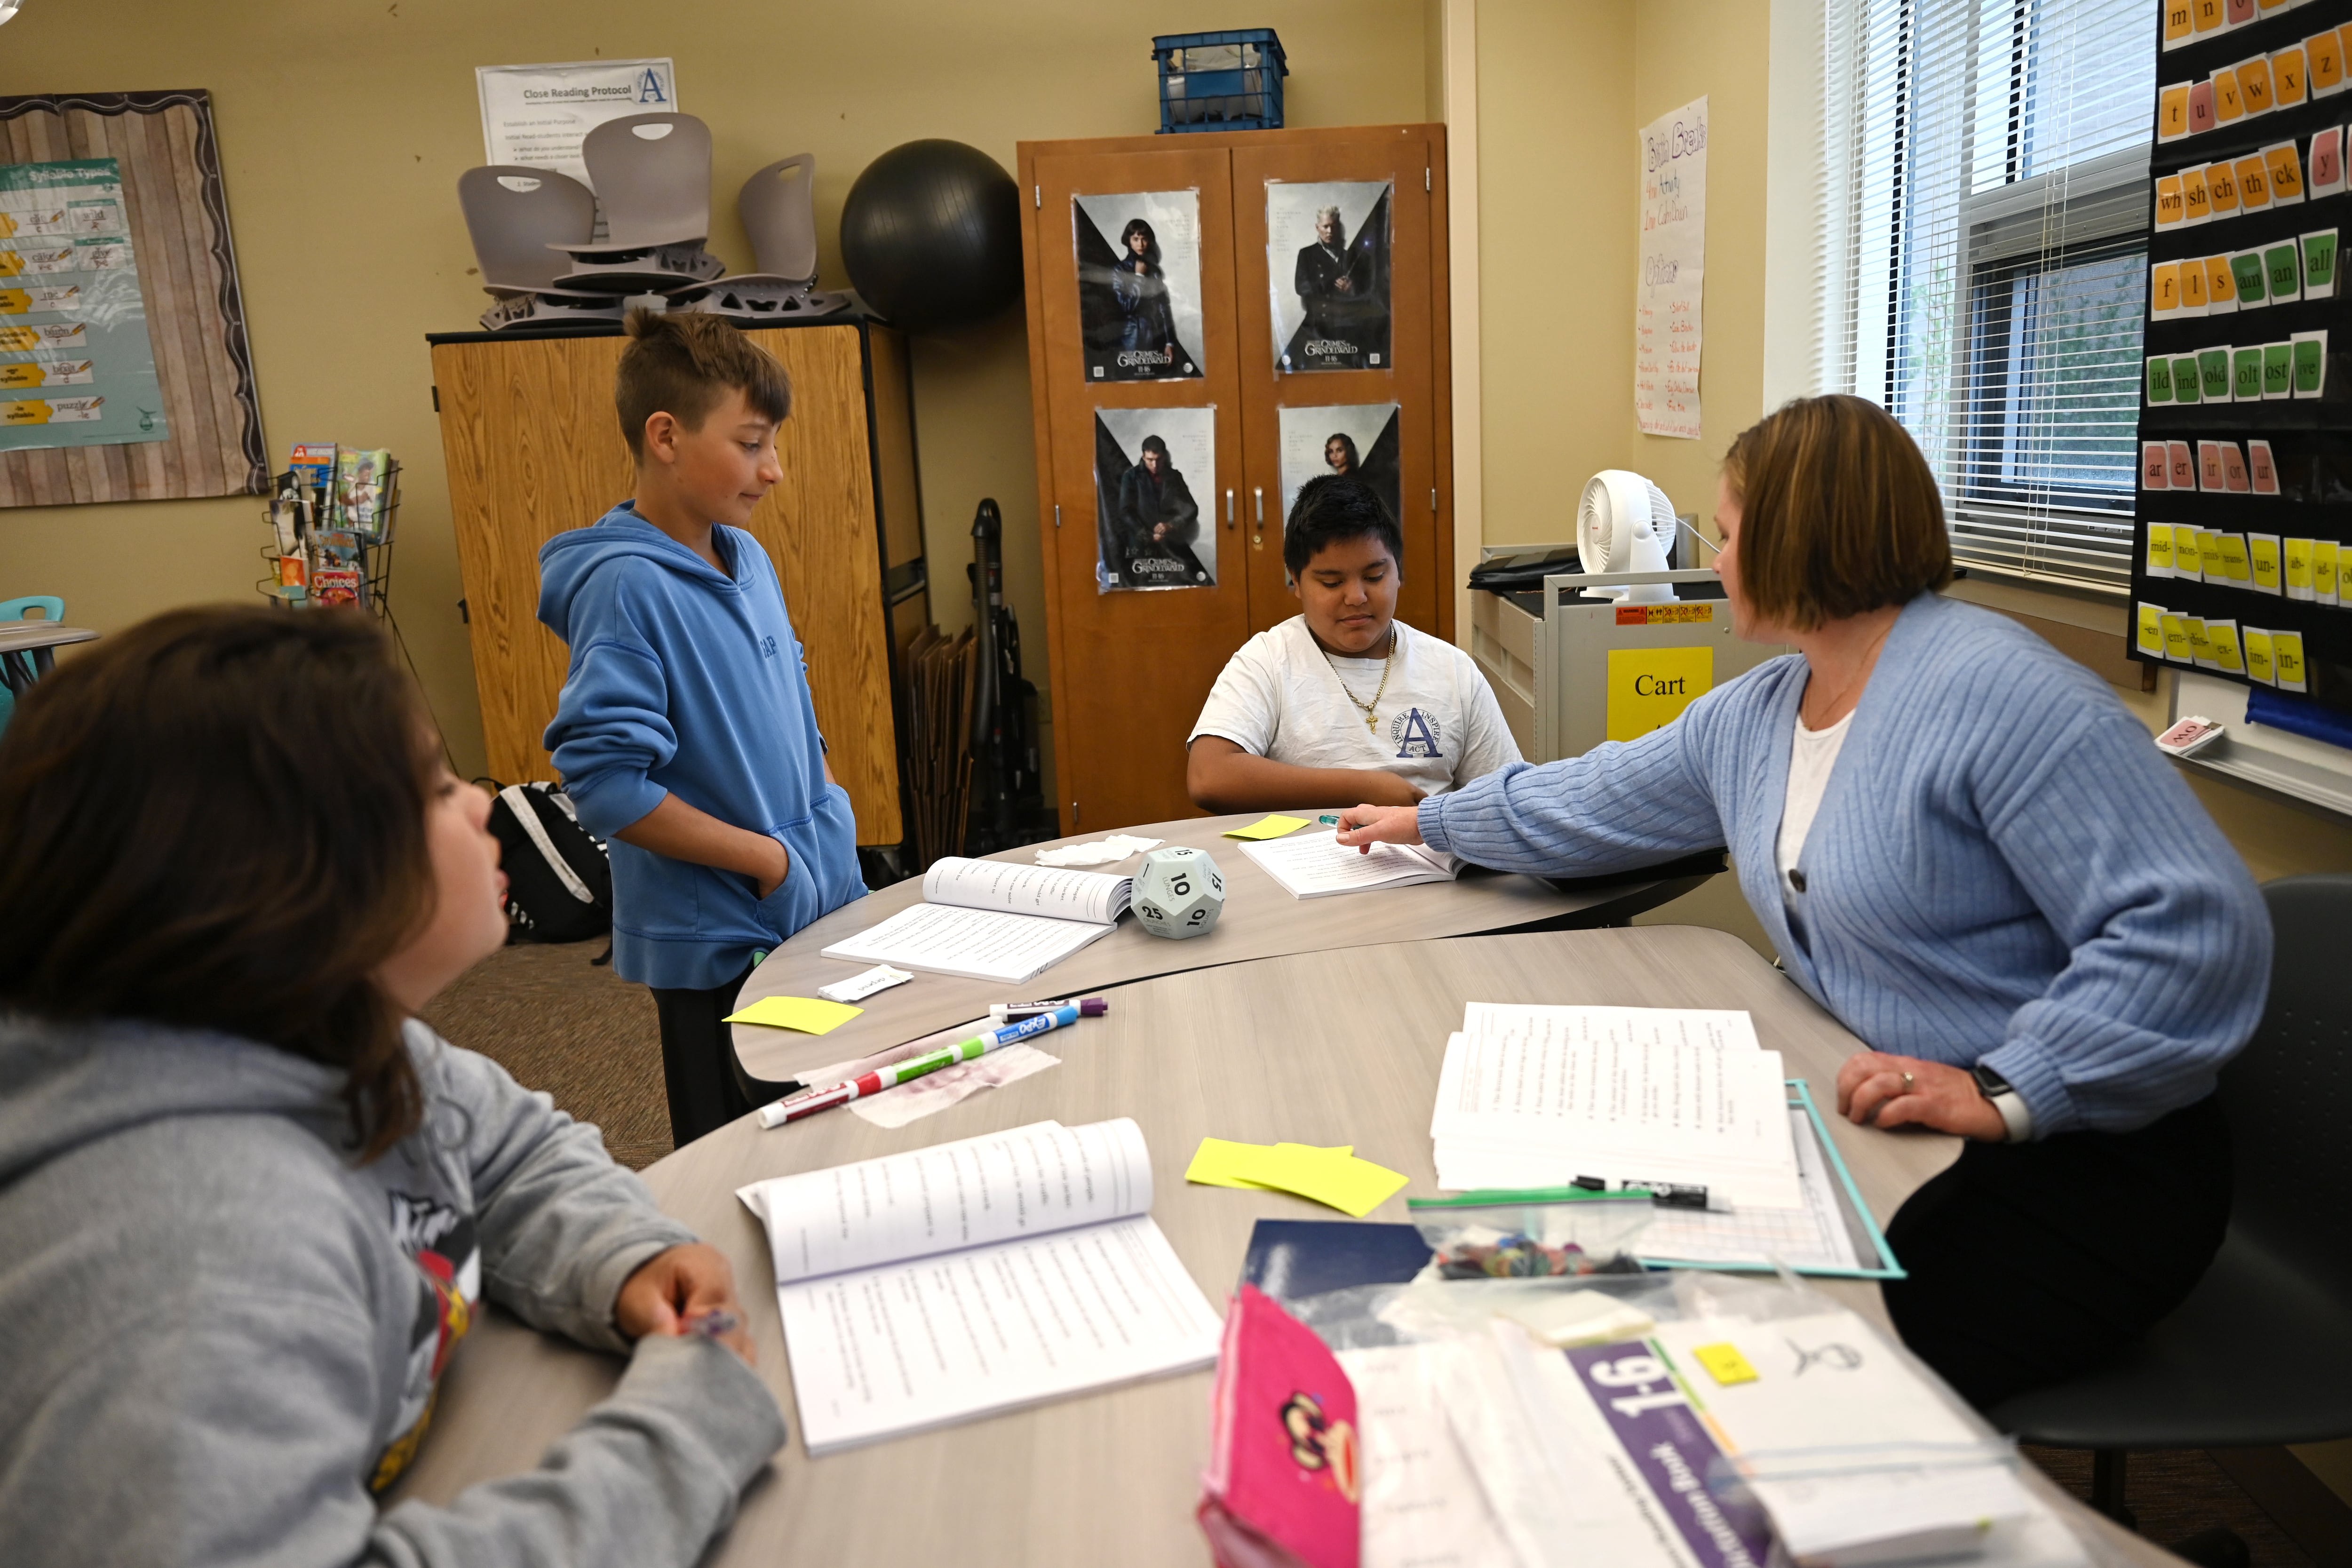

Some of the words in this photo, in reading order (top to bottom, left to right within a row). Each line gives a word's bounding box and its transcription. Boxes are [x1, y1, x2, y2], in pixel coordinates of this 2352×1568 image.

[2171, 9, 2186, 26] m
[2203, 2, 2214, 17] n
[524, 89, 549, 99] Close
[551, 87, 590, 98] Reading
[592, 84, 632, 95] Protocol
[639, 68, 667, 103] A
[2172, 105, 2178, 122] t
[2196, 103, 2206, 119] u
[2225, 91, 2235, 106] v
[2249, 81, 2263, 98] w
[2285, 74, 2296, 90] x
[2321, 56, 2331, 73] z
[2160, 191, 2181, 210] wh
[2189, 186, 2206, 207] sh
[2214, 177, 2234, 199] ch
[2246, 173, 2263, 195] th
[2275, 164, 2296, 184] ck
[2320, 154, 2330, 177] y
[2164, 278, 2172, 298] f
[2217, 274, 2225, 289] s
[2239, 273, 2260, 289] am
[2273, 266, 2293, 284] an
[2310, 249, 2331, 272] all
[2152, 371, 2170, 390] ild
[2177, 372, 2198, 390] ind
[2206, 366, 2226, 383] old
[2238, 365, 2257, 384] olt
[2265, 361, 2287, 380] ost
[2149, 460, 2162, 477] ar
[2175, 461, 2187, 476] er
[2151, 541, 2170, 552] mid-
[2178, 544, 2198, 556] non-
[2255, 558, 2275, 573] un-
[314, 575, 357, 588] Choices
[2168, 632, 2186, 643] em-
[2190, 633, 2209, 647] dis-
[2217, 644, 2232, 654] ex-
[2249, 648, 2268, 665] im-
[2279, 649, 2299, 669] in-
[1635, 674, 1686, 696] Cart
[1392, 712, 1409, 744] INQUIRE
[1396, 708, 1443, 758] A
[1421, 711, 1439, 742] INSPIRE
[1162, 877, 1175, 902] LUNGES
[1171, 873, 1191, 896] 10
[1212, 873, 1222, 892] 15
[1142, 906, 1163, 920] 25
[1186, 909, 1206, 926] 10
[1199, 908, 1214, 929] SQUATS
[857, 977, 885, 991] depend
[1018, 1017, 1047, 1035] EXPO
[1650, 1440, 1701, 1493] Book
